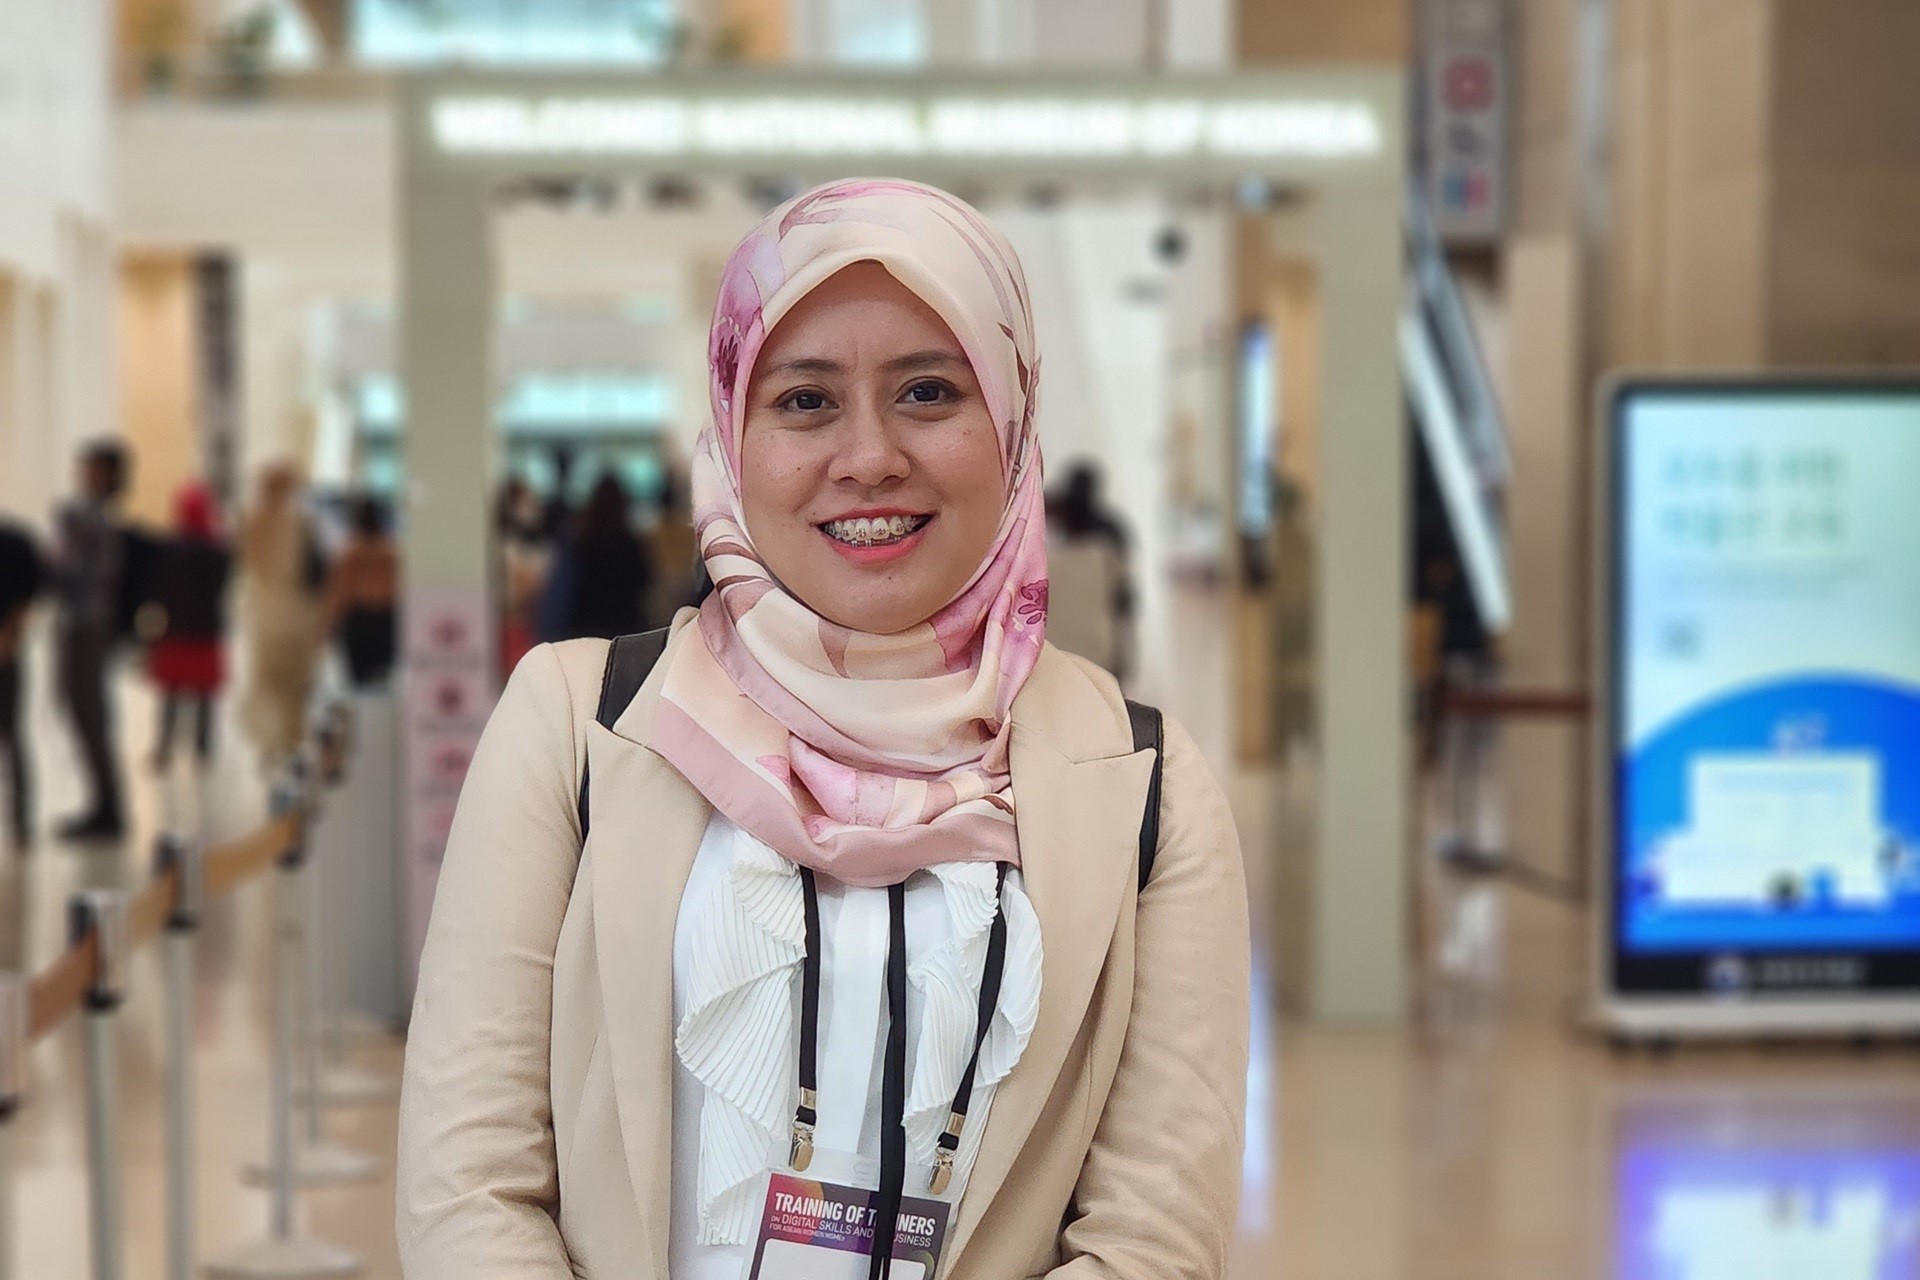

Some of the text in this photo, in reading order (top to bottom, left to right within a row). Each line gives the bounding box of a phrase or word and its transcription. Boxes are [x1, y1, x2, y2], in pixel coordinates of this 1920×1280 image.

[775, 1192, 844, 1221] TRAINING
[845, 1205, 866, 1225] OF
[769, 1223, 782, 1231] FOR
[782, 1213, 817, 1229] DIGITAL
[818, 1220, 852, 1235] SKILLS
[852, 1227, 874, 1239] AND
